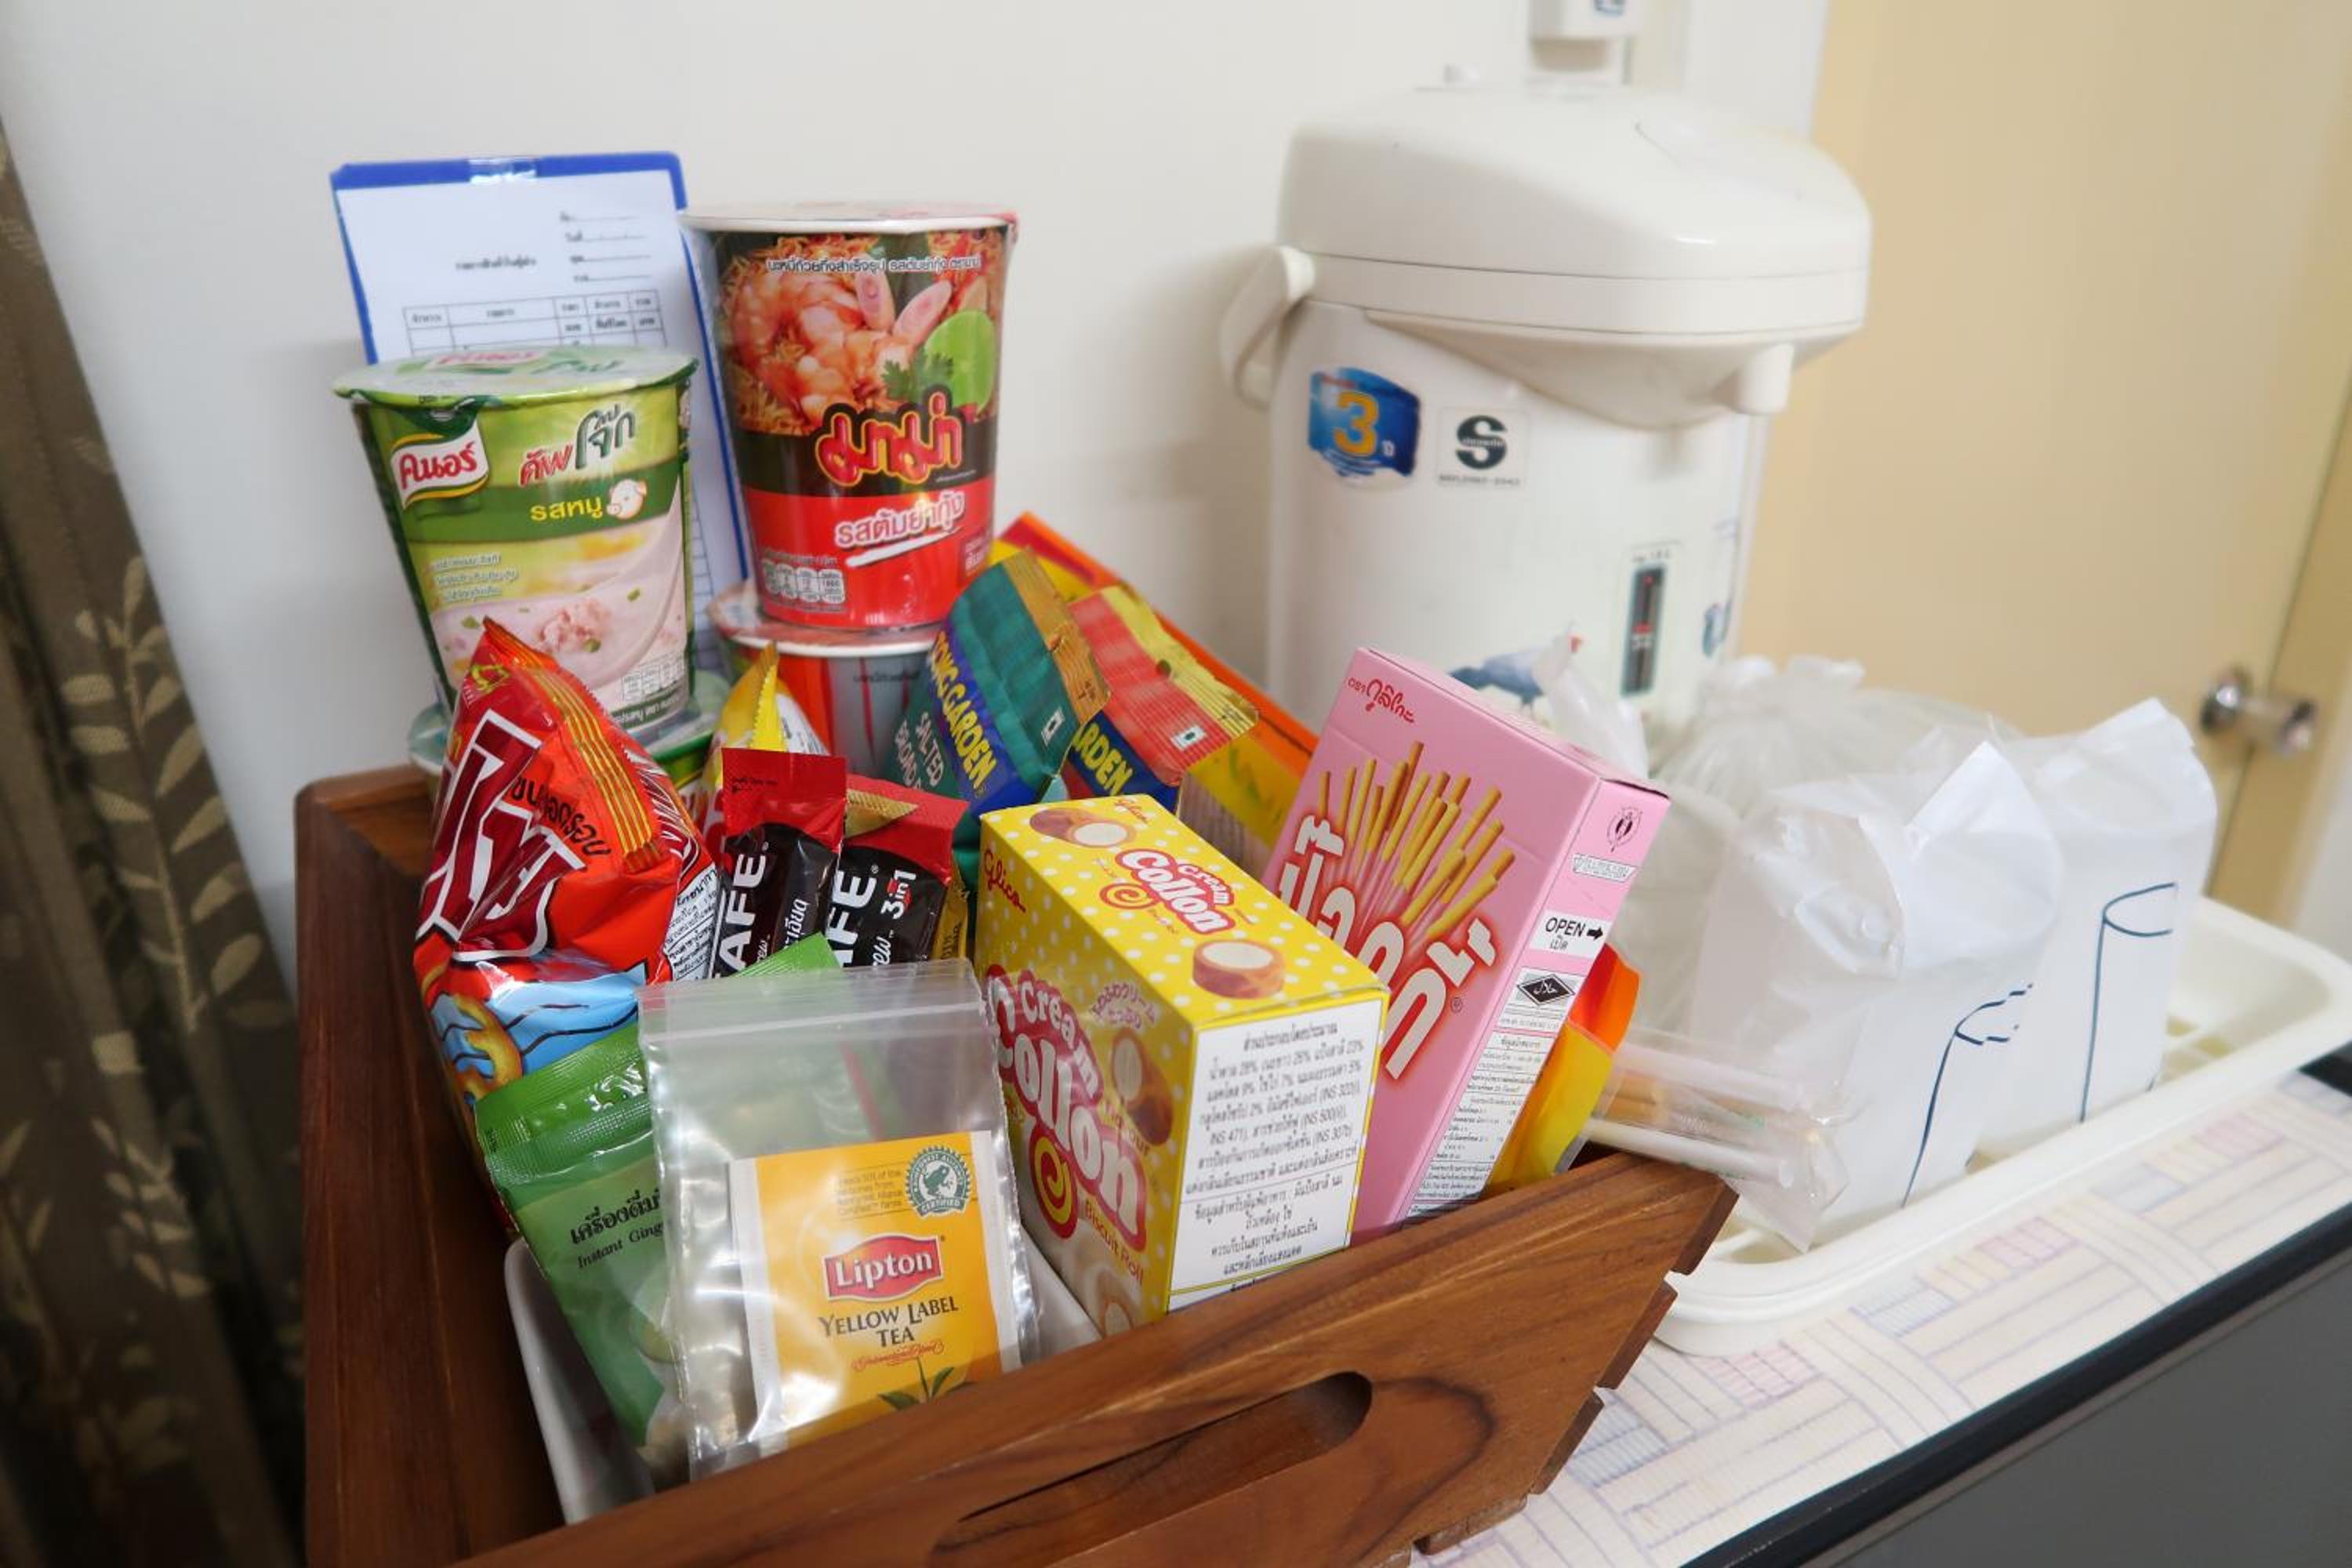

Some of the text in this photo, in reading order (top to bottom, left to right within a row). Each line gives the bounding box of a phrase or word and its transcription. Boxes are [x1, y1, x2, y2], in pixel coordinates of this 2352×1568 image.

[815, 391, 963, 486] มาม่า
[1334, 390, 1377, 456] 3
[399, 440, 479, 490] คนอร์
[530, 495, 603, 521] รสหมู
[836, 491, 966, 546] รสต้มยำกุ้ง
[943, 683, 997, 789] GARDEN
[1072, 722, 1134, 796] RDEN
[1120, 850, 1229, 932] Collon
[1178, 865, 1230, 905] Cream
[719, 854, 768, 972] AFE
[1544, 916, 1585, 938] OPEN
[1021, 979, 1098, 1099] Cream
[577, 1240, 624, 1269] Instant
[836, 1250, 934, 1290] Lipton
[1120, 1245, 1145, 1286] Roll
[818, 1295, 960, 1338] YELLOW LABEL
[876, 1327, 916, 1348] TEA
